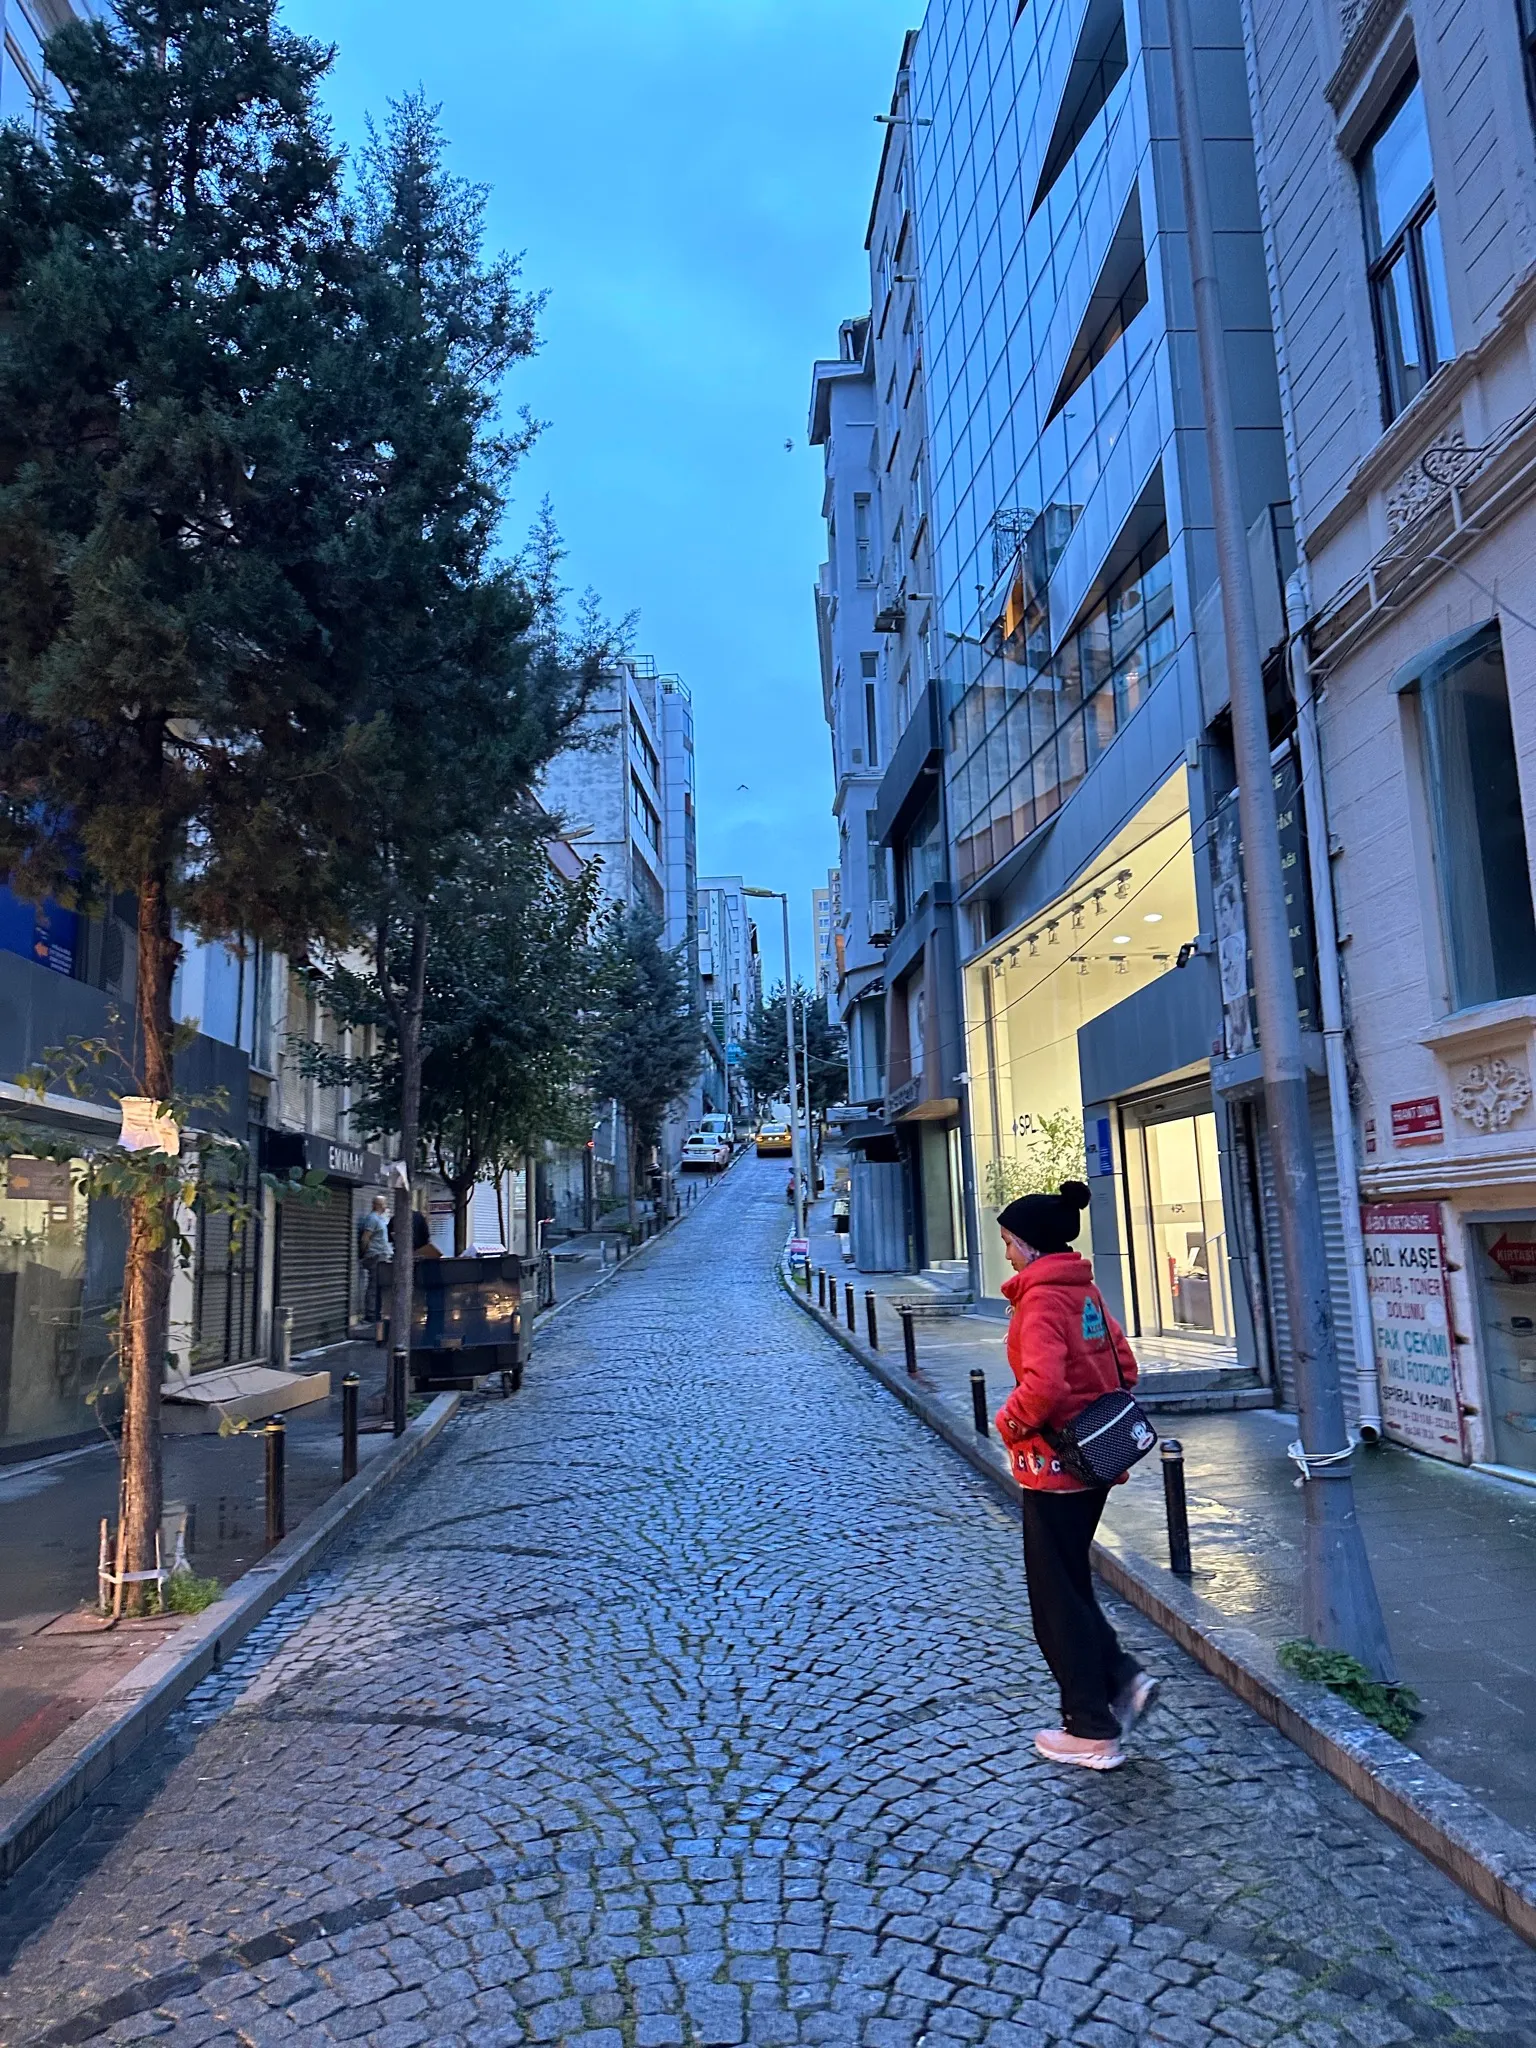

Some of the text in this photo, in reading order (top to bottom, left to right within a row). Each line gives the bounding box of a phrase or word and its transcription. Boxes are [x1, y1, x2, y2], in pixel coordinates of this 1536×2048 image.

[1018, 1113, 1036, 1136] SPL
[1365, 1243, 1438, 1273] ACİL KAŞE
[1497, 1246, 1536, 1262] KIRTASİ
[1409, 1277, 1441, 1297] TONER
[1376, 1327, 1401, 1351] FAX
[1407, 1361, 1451, 1387] FOTOKOP
